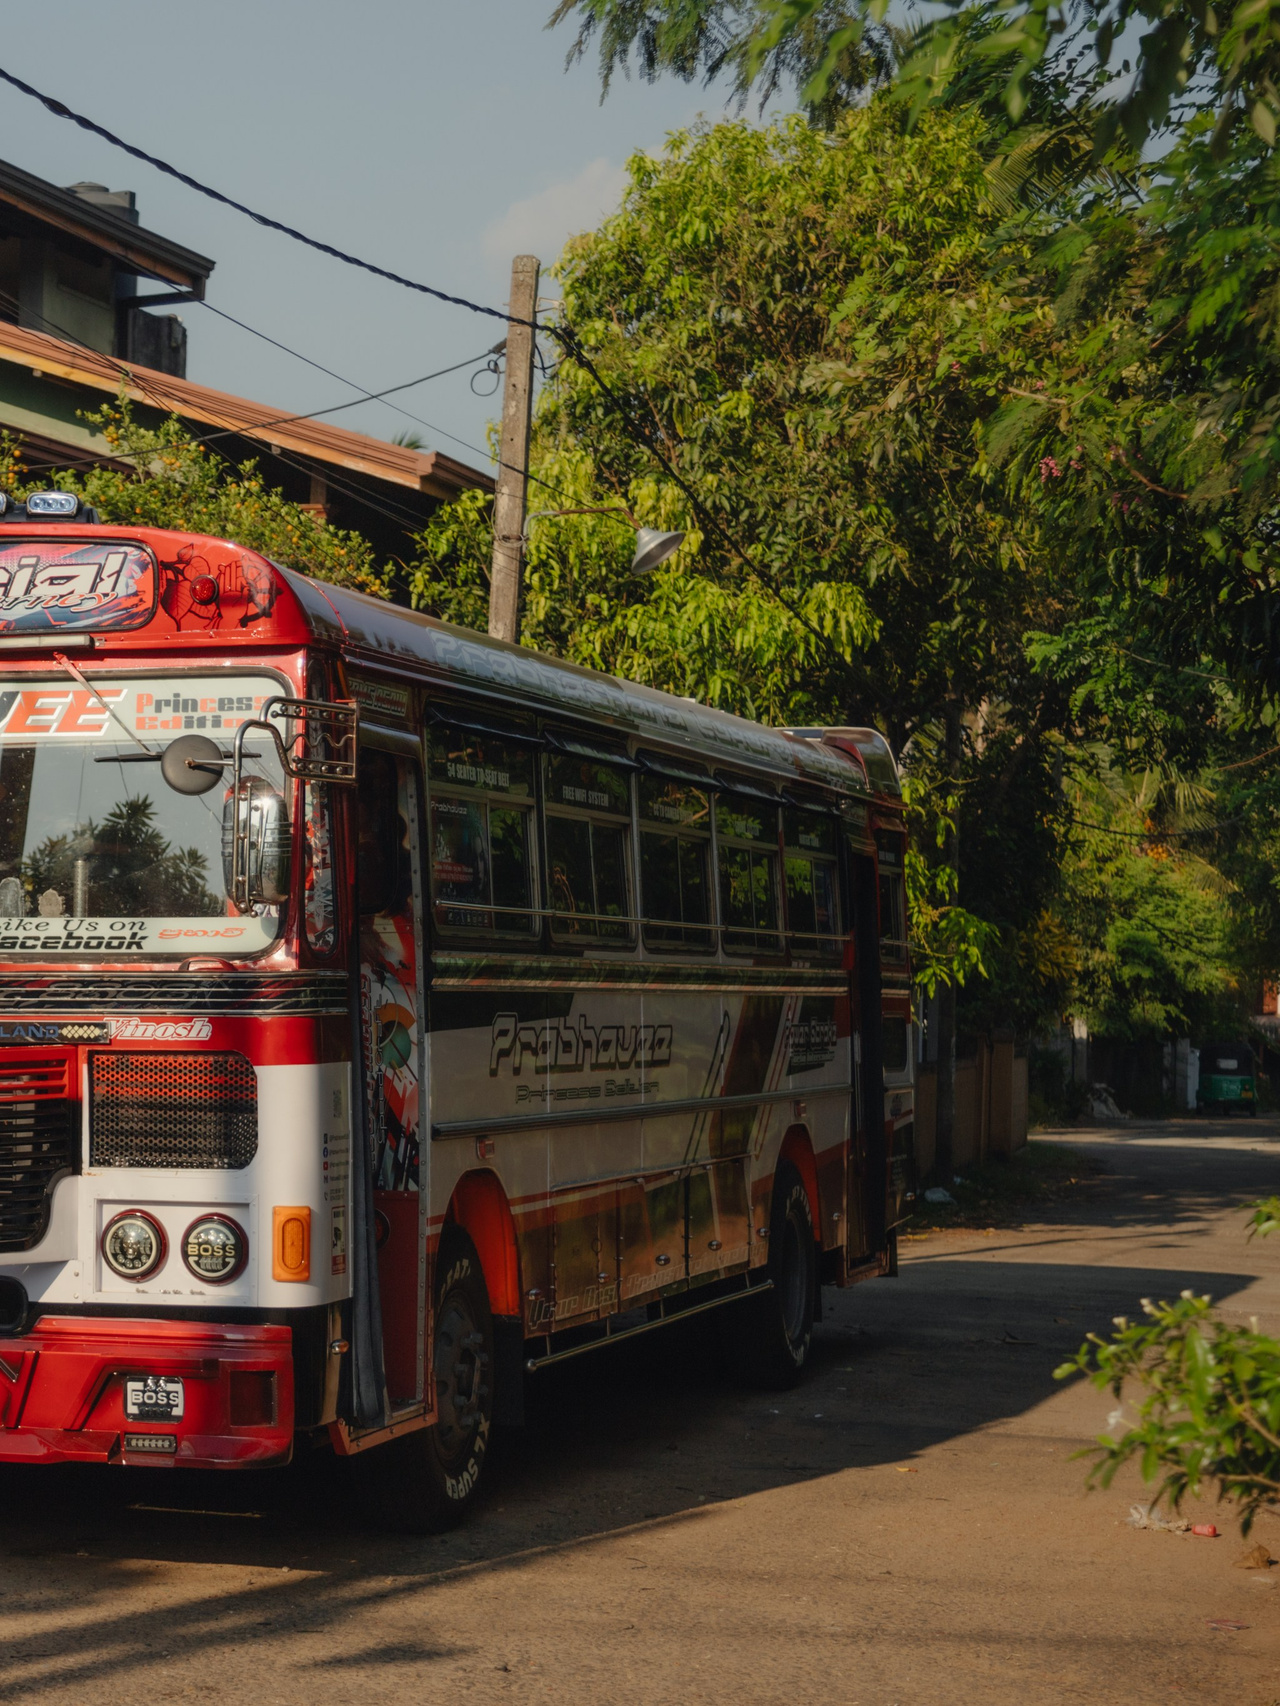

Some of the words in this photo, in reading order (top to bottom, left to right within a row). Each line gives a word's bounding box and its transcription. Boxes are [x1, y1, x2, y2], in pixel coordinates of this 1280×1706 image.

[63, 919, 99, 931] Us
[109, 921, 148, 931] on
[104, 1017, 213, 1040] Vinosh
[187, 1243, 236, 1257] BOSS
[131, 1391, 179, 1405] BOSS
